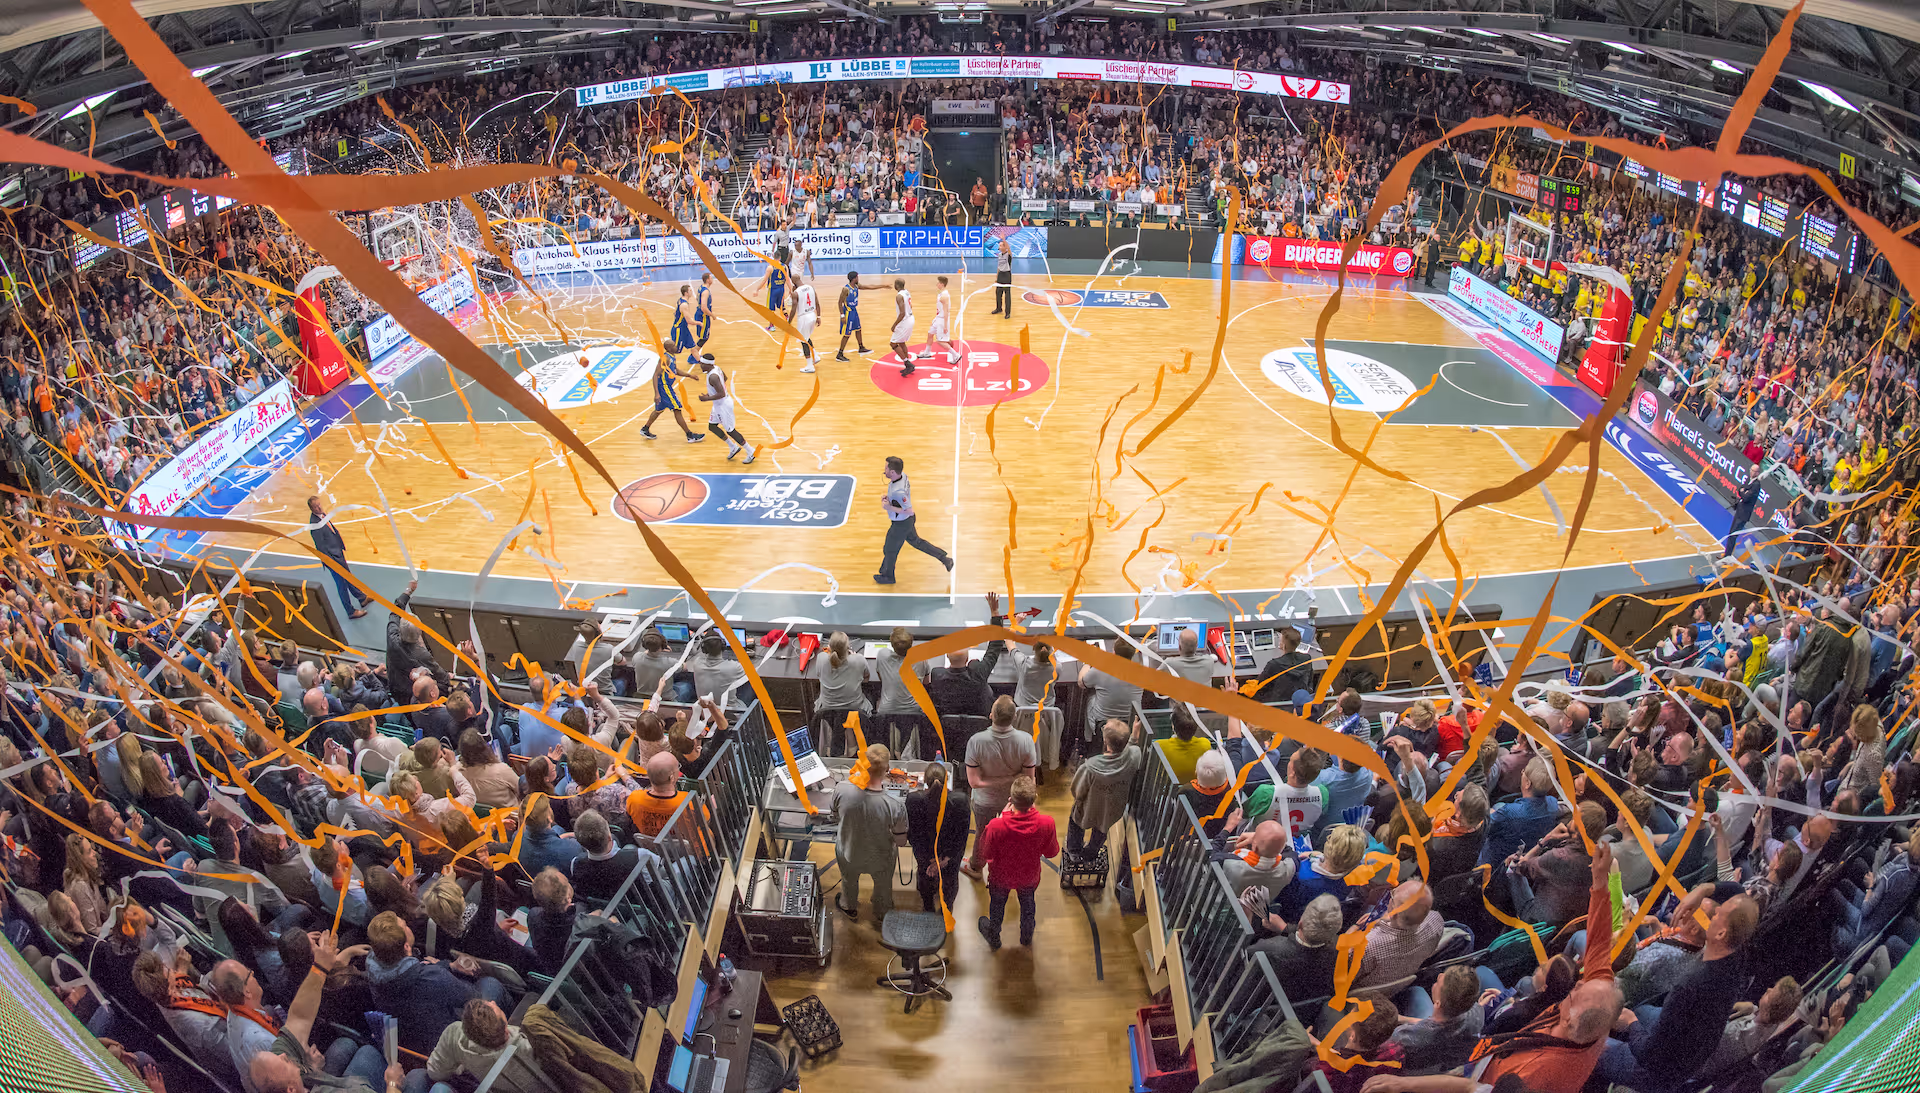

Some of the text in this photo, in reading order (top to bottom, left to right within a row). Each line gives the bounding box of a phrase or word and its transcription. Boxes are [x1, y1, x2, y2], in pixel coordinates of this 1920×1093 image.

[842, 60, 890, 72] LÜBBE
[968, 59, 1041, 69] Lüschen & Partner
[1106, 62, 1176, 76] Lüschen & Partner
[606, 80, 647, 94] LÜBBE
[1544, 180, 1557, 190] 9:59
[1566, 185, 1580, 195] 9:59
[1724, 180, 1743, 196] 9:59
[1544, 191, 1555, 206] 23
[1565, 197, 1578, 211] 23
[194, 202, 208, 216] 0-0
[1721, 201, 1736, 215] 0-0
[708, 233, 851, 247] Autohaus Kus Hörsting
[882, 230, 981, 245] TRIPHAUS
[536, 249, 579, 261] Autohau
[582, 244, 610, 256] Klaus
[714, 251, 756, 260] ssen/Oldb.
[1285, 244, 1342, 264] BURGER
[807, 293, 811, 306] 4
[1095, 292, 1151, 300] BBL
[1454, 284, 1482, 306] APOTHEKE
[1521, 327, 1558, 356] APOTHEKE
[328, 362, 339, 373] LzO
[593, 352, 627, 379] PASST.
[1589, 364, 1599, 375] LzO
[967, 378, 1031, 391] LzO
[1354, 368, 1391, 394] SMILE
[1364, 362, 1408, 396] SERVICE
[1326, 372, 1355, 402] ASST.
[1640, 397, 1657, 414] SPORT
[1640, 406, 1654, 418] 2000
[208, 429, 229, 448] Kunden
[213, 442, 224, 456] Zeit
[193, 453, 229, 485] Fam-Center
[1641, 451, 1706, 495] EWE
[1662, 426, 1765, 519] Vechta www.marcels-sport-.de
[1705, 442, 1736, 475] Sport
[1734, 466, 1770, 504] Ceer
[740, 478, 838, 500] BBL
[726, 499, 800, 512] Credit
[1275, 796, 1320, 804] KTVERSCHLUSS
